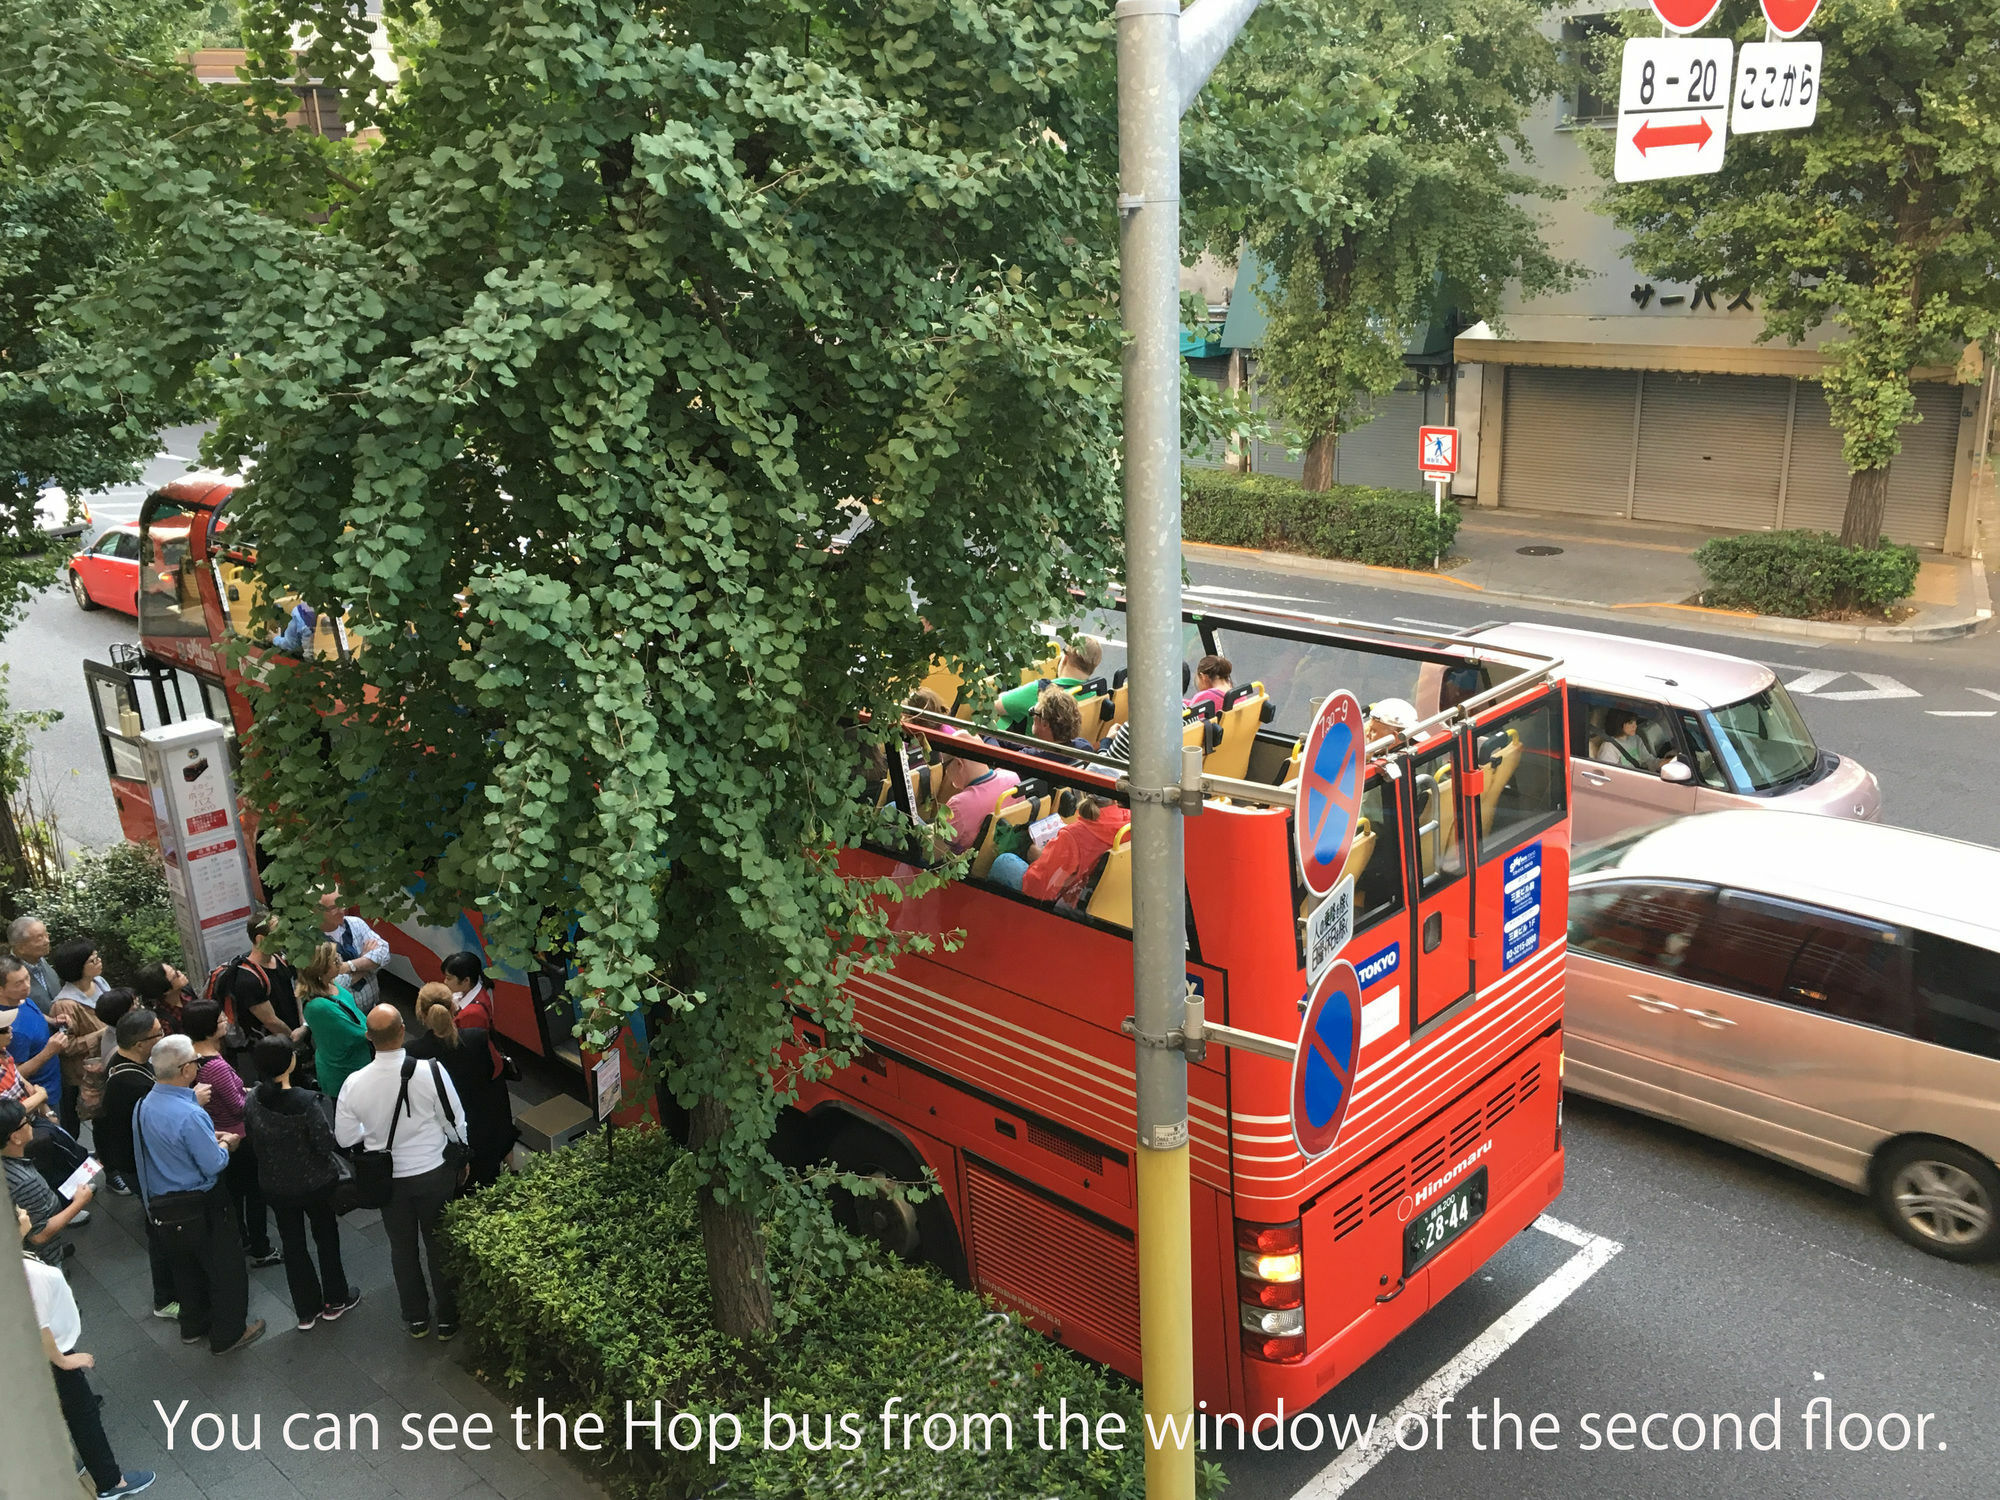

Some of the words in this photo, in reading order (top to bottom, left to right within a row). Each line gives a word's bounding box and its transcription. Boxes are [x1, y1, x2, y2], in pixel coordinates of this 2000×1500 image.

[1740, 63, 1814, 110] ここから
[1358, 951, 1397, 983] TOKYO
[1415, 1139, 1493, 1207] Hinomaru
